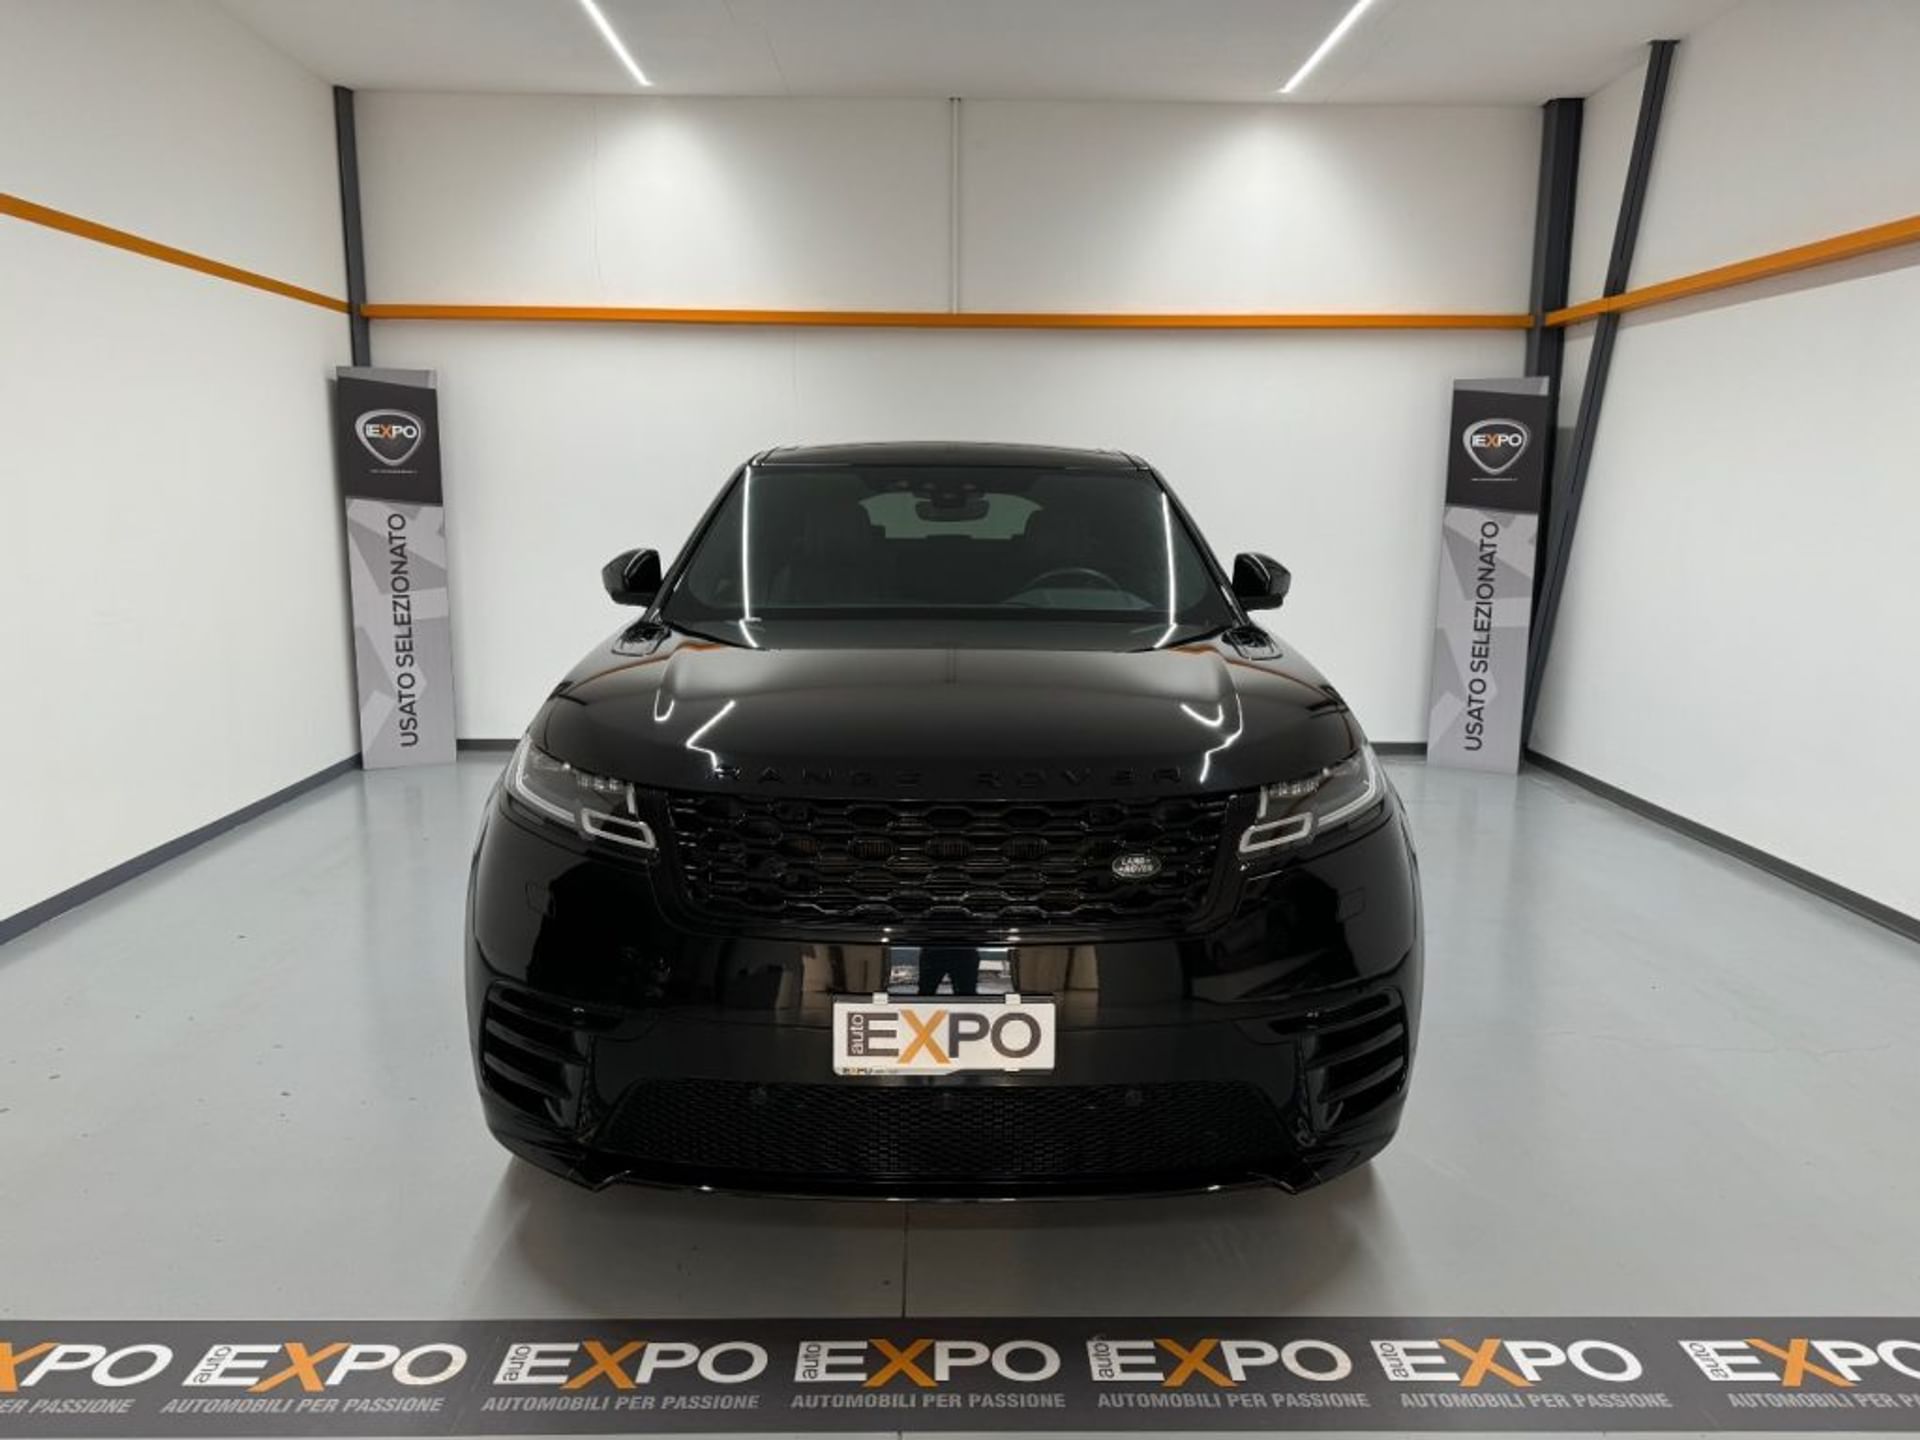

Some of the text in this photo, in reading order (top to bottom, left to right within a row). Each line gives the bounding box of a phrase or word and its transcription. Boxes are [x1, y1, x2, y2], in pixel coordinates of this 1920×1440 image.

[387, 513, 419, 747] USATO SELEZIONATO
[1464, 521, 1500, 752] USATO SELEZIONATO
[712, 766, 1182, 786] RANGE ROVER
[847, 1008, 1042, 1065] auto EXPO
[182, 1342, 468, 1392] auto EXPO
[493, 1340, 768, 1389] auto EXPO
[794, 1338, 1060, 1387] auto EXPO
[1086, 1338, 1352, 1387] auto EXPO
[1370, 1338, 1642, 1387] auto EXPO
[1689, 1343, 1729, 1379] auto
[28, 1398, 136, 1413] PASSIONE
[160, 1397, 446, 1414] AUTOMOBILI PER PASSIONE
[481, 1395, 760, 1412] AUTOMOBILI PER PASSIONE
[790, 1393, 1067, 1408] AUTOMOBILI PER PASSIONE
[1097, 1393, 1372, 1408] AUTOMOBILI PER PASSIONE
[1400, 1393, 1674, 1408] AUTOMOBILI PER PASSIONE
[1728, 1393, 1855, 1408] AUTOMOBILI
[1852, 1393, 1900, 1408] PER
